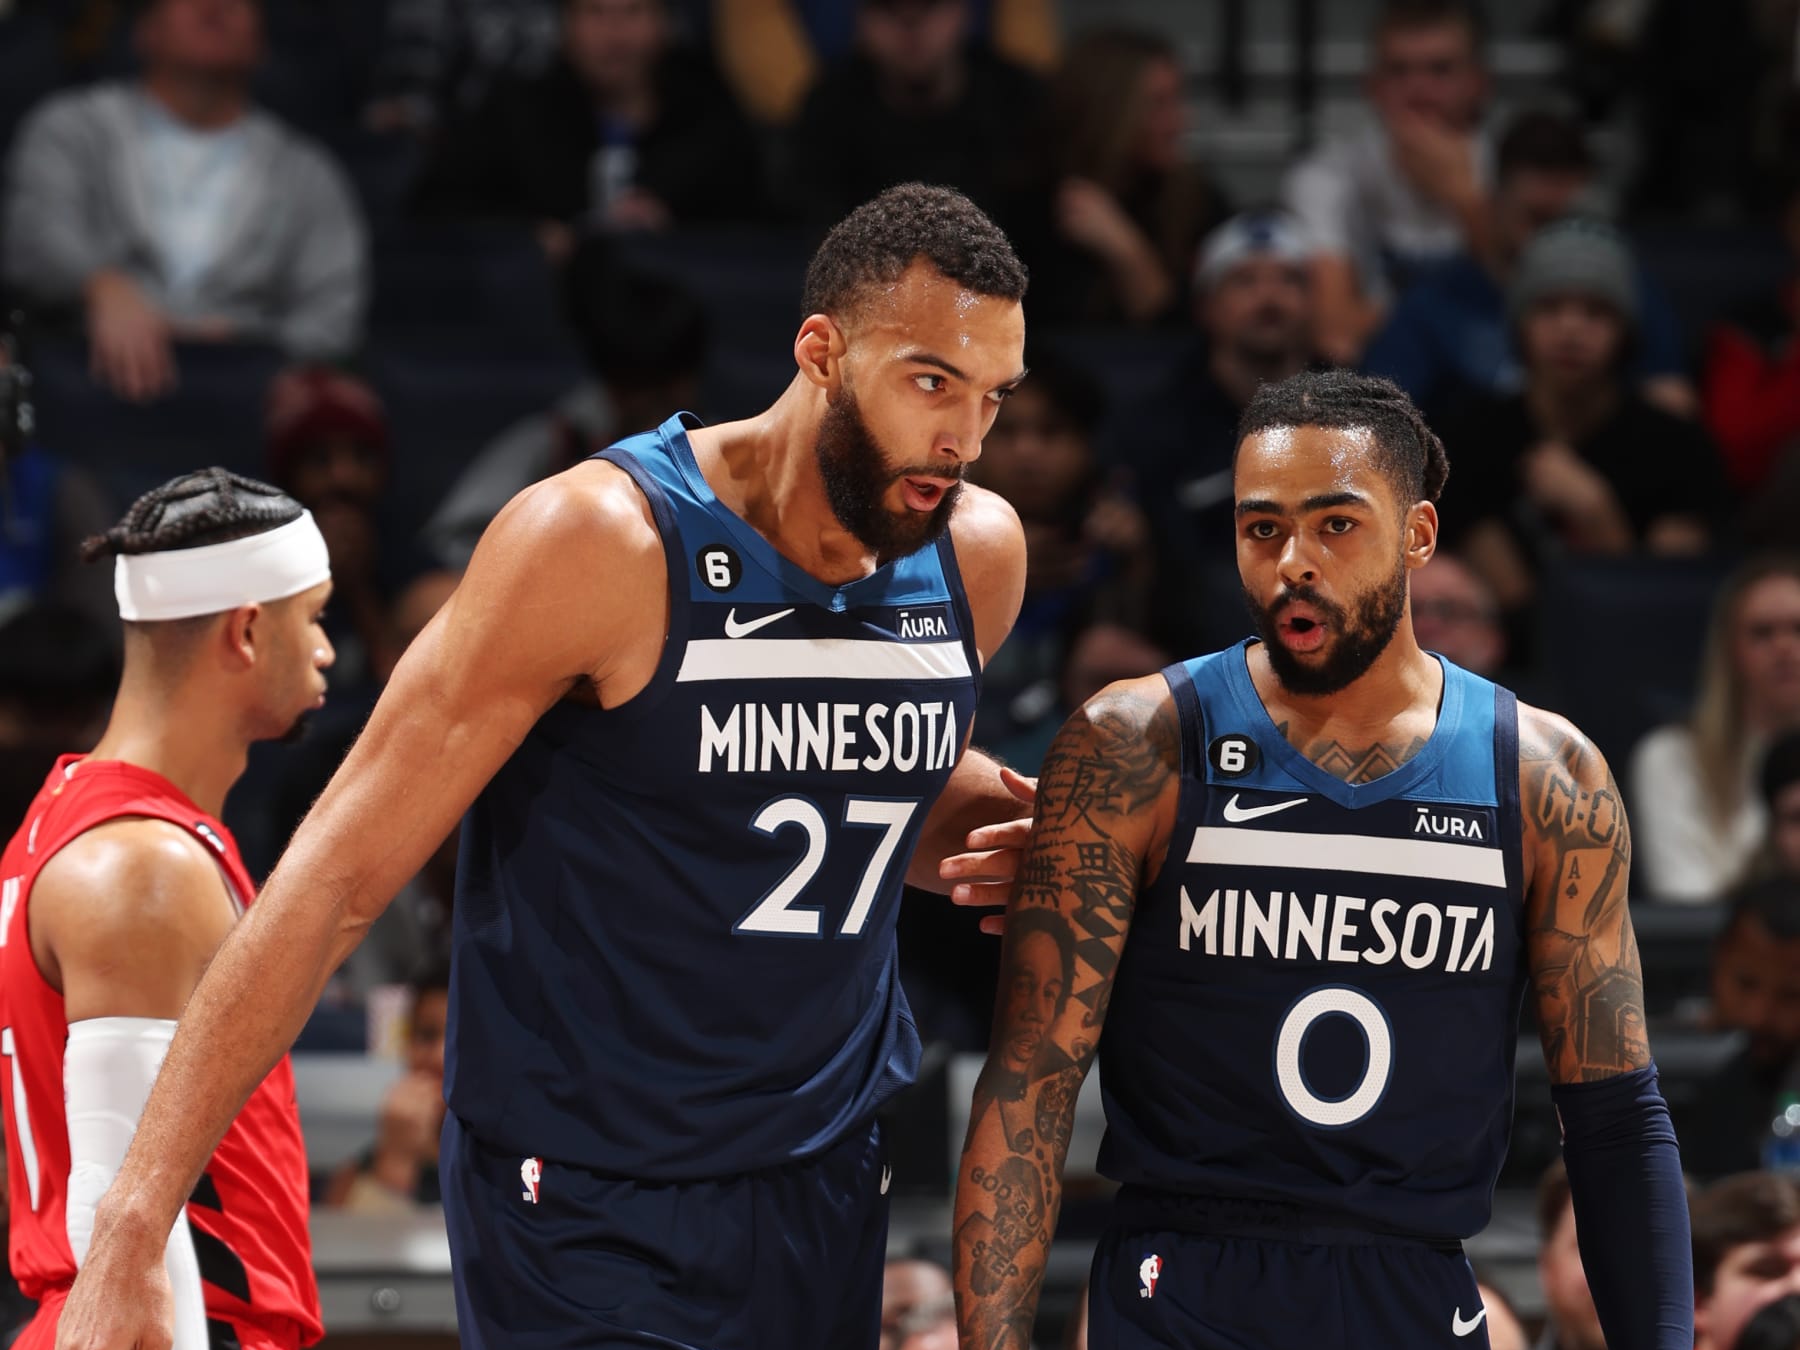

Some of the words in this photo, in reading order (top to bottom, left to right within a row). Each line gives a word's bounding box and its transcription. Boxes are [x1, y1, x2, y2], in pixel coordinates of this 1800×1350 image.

[703, 551, 731, 588] 6
[699, 701, 957, 773] MINNESOTA
[1219, 740, 1247, 773] 6
[734, 795, 921, 937] 27
[1179, 885, 1495, 973] MINNESOTA
[1274, 985, 1393, 1128] 0
